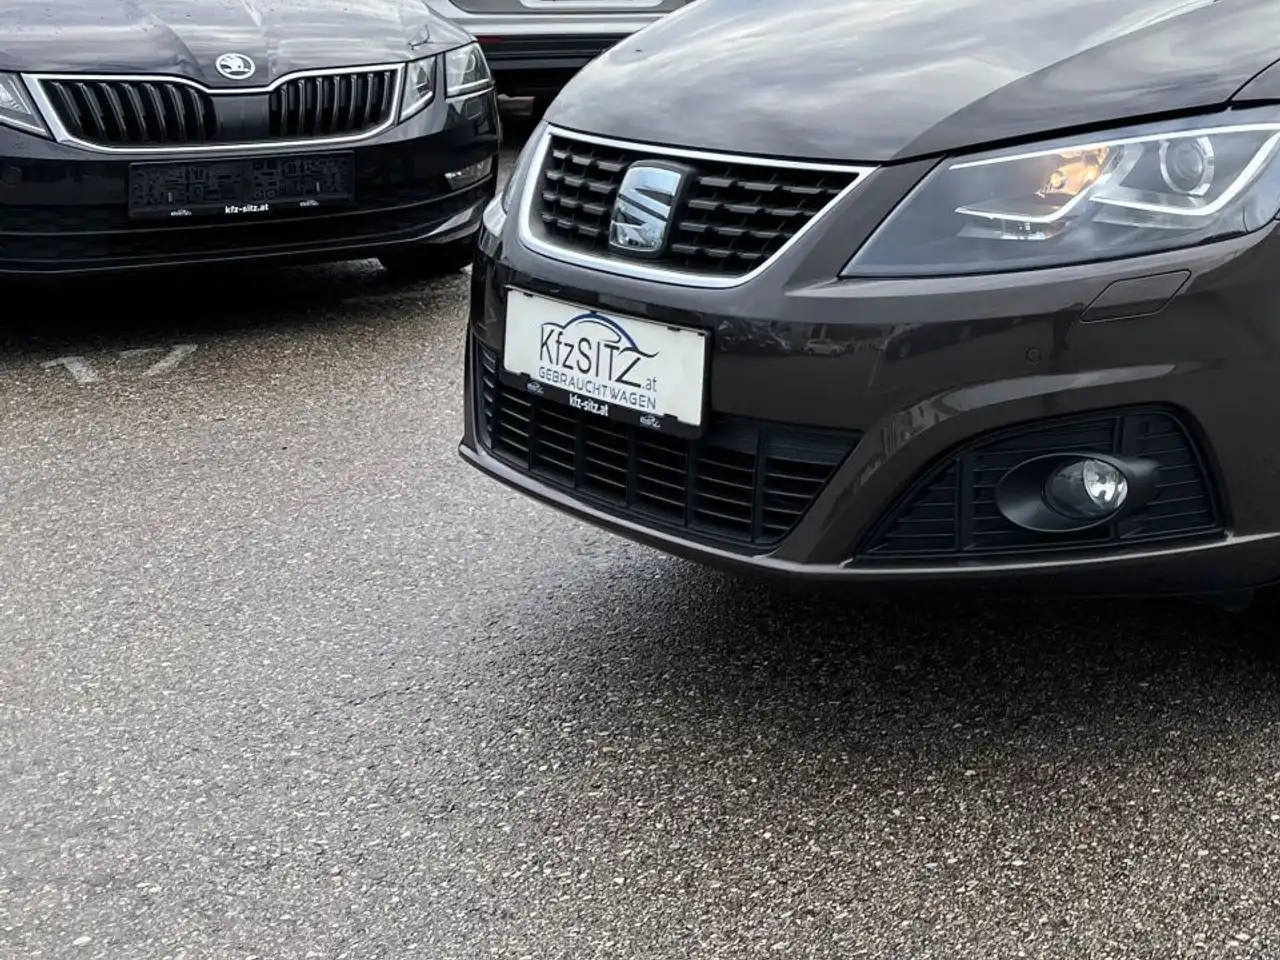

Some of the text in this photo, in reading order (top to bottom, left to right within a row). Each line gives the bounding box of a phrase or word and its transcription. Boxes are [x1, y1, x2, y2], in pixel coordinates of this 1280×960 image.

[225, 203, 269, 214] kfz-sitz.at
[538, 366, 657, 410] GEBRAUCHTWAGEN
[569, 393, 609, 417] kfz-sitz.at
